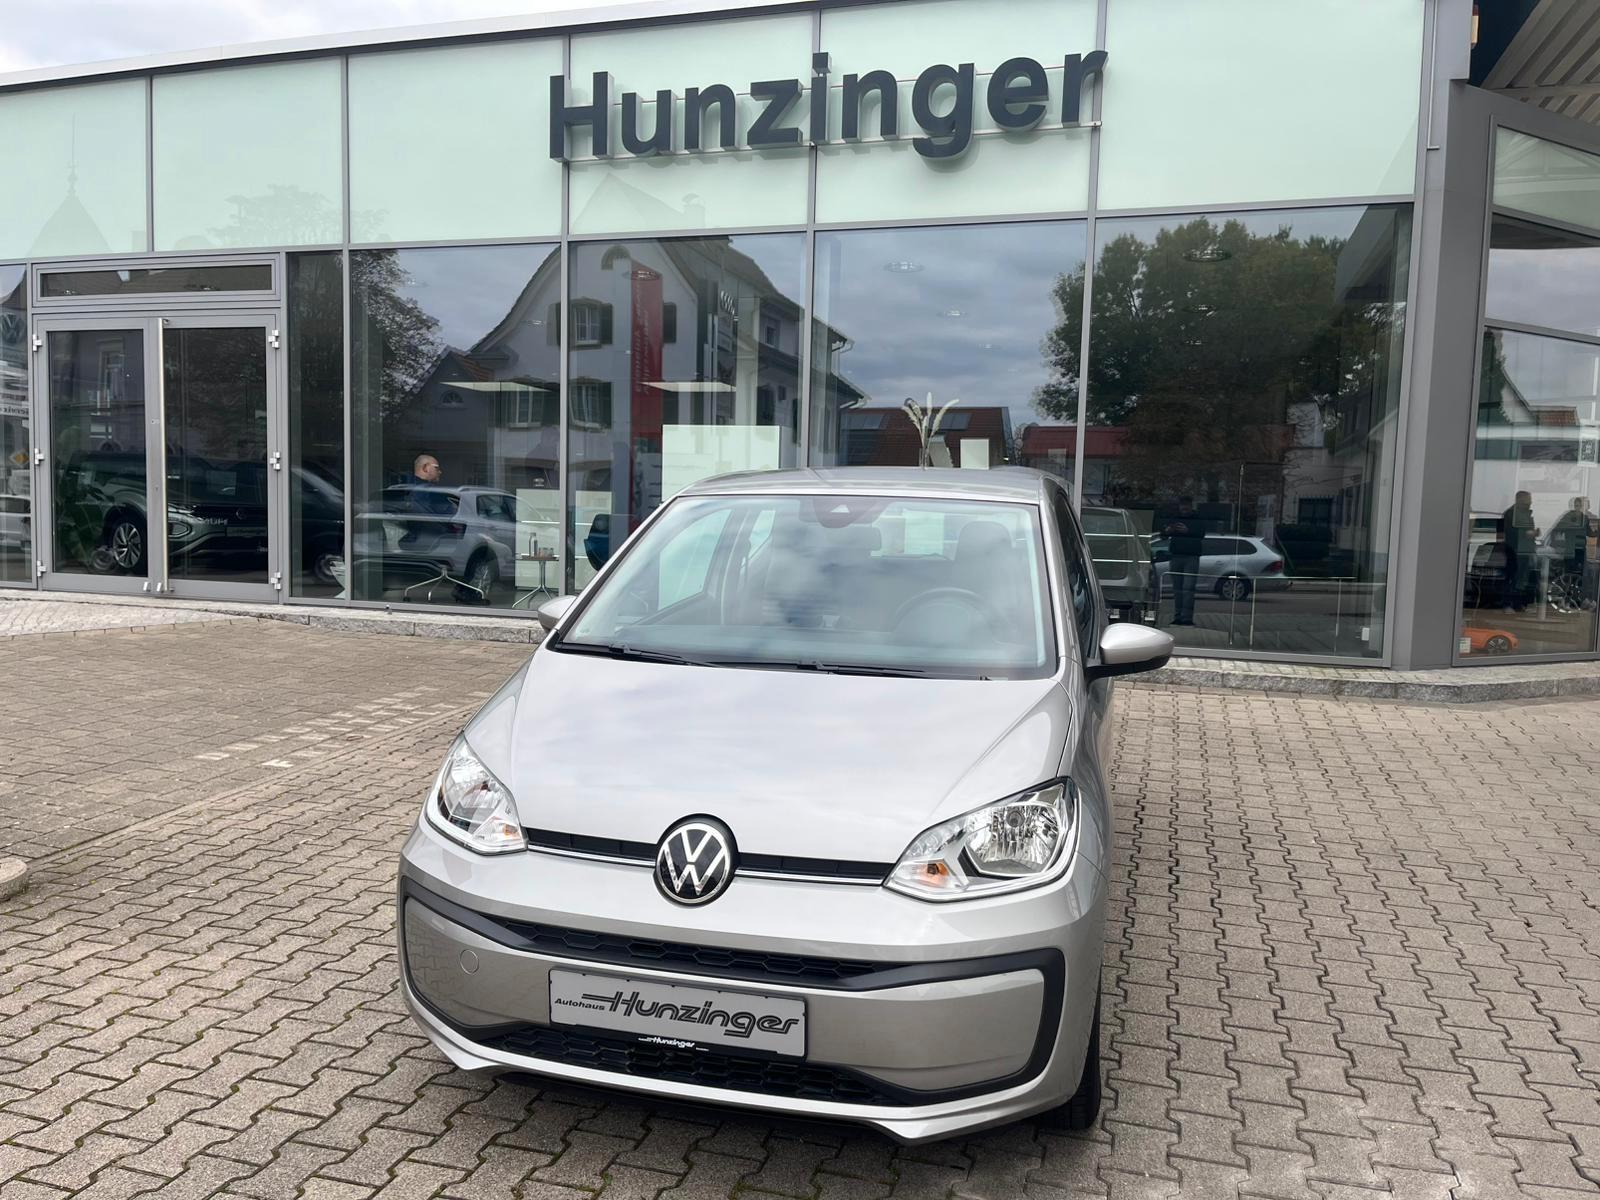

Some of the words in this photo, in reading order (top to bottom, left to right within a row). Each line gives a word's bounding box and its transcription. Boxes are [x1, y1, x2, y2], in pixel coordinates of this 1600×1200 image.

[549, 50, 1108, 161] Hunzinger
[554, 998, 605, 1011] Autohaus
[581, 991, 800, 1039] Hunzinger
[644, 1036, 696, 1048] Hunzinger
